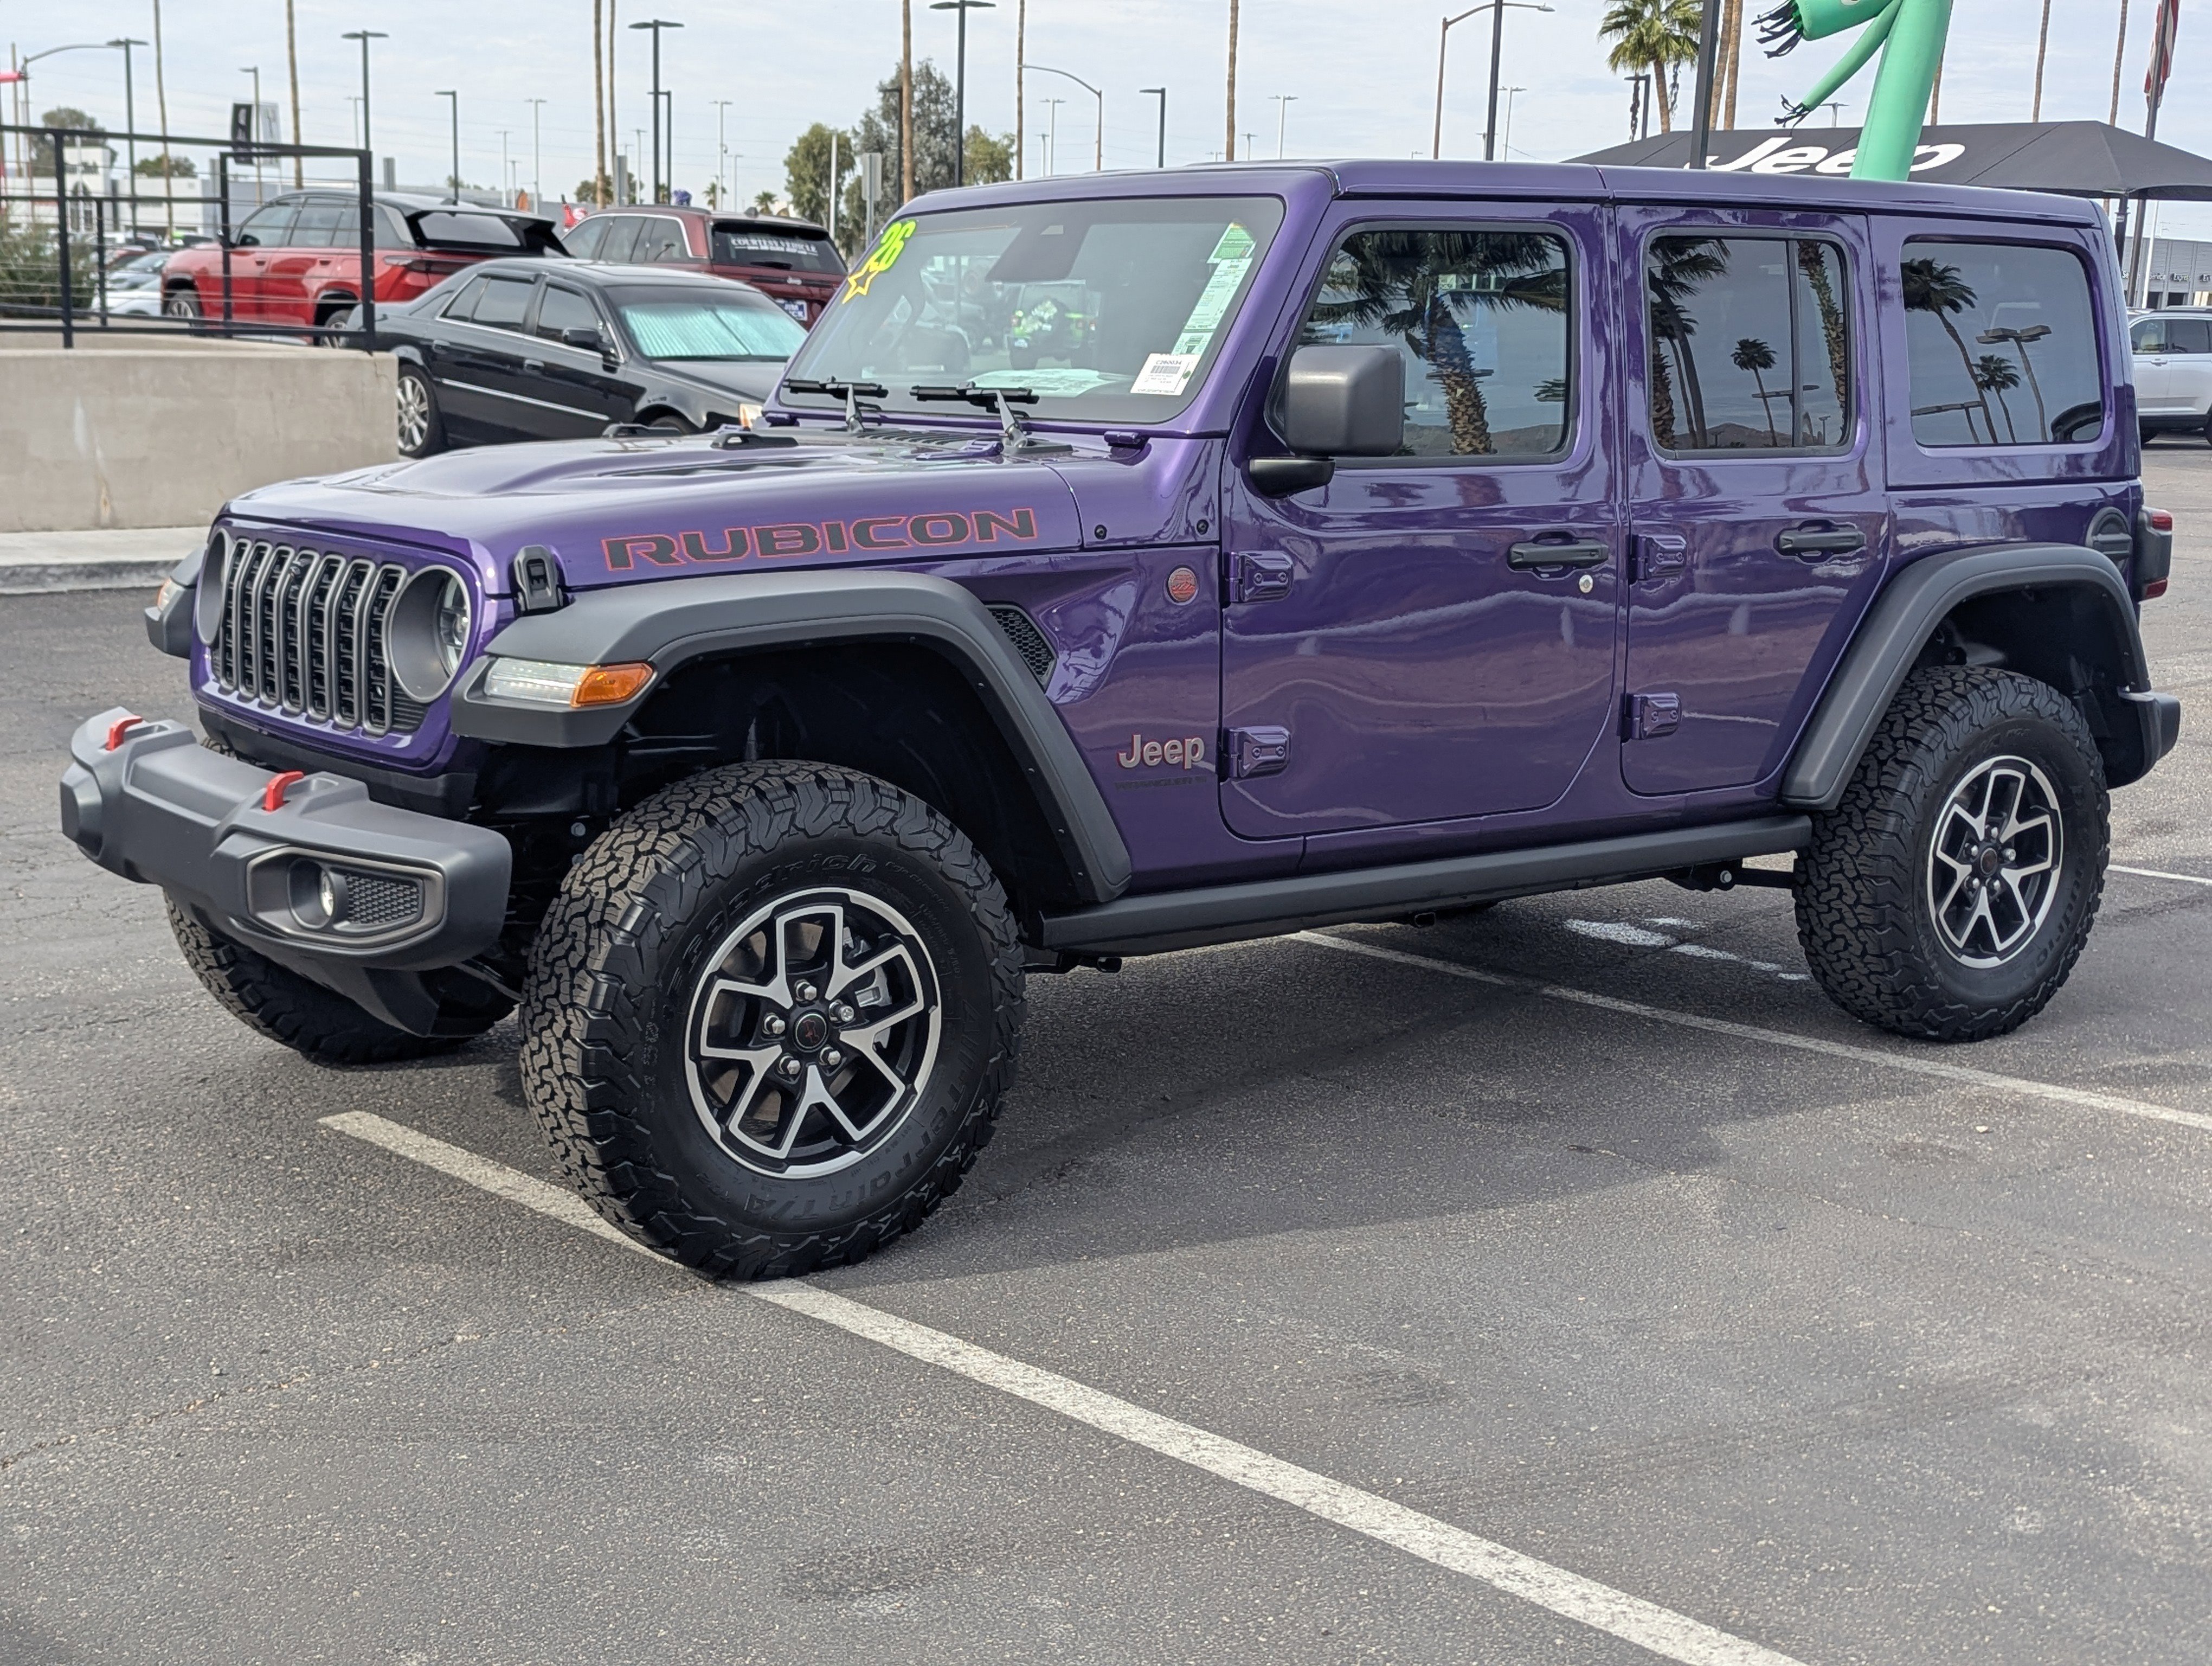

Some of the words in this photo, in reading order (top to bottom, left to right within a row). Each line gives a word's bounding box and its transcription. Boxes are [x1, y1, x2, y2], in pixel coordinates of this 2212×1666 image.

[731, 236, 780, 247] COURTESY
[601, 508, 1039, 571] RUBICON
[1117, 734, 1205, 770] Jeep
